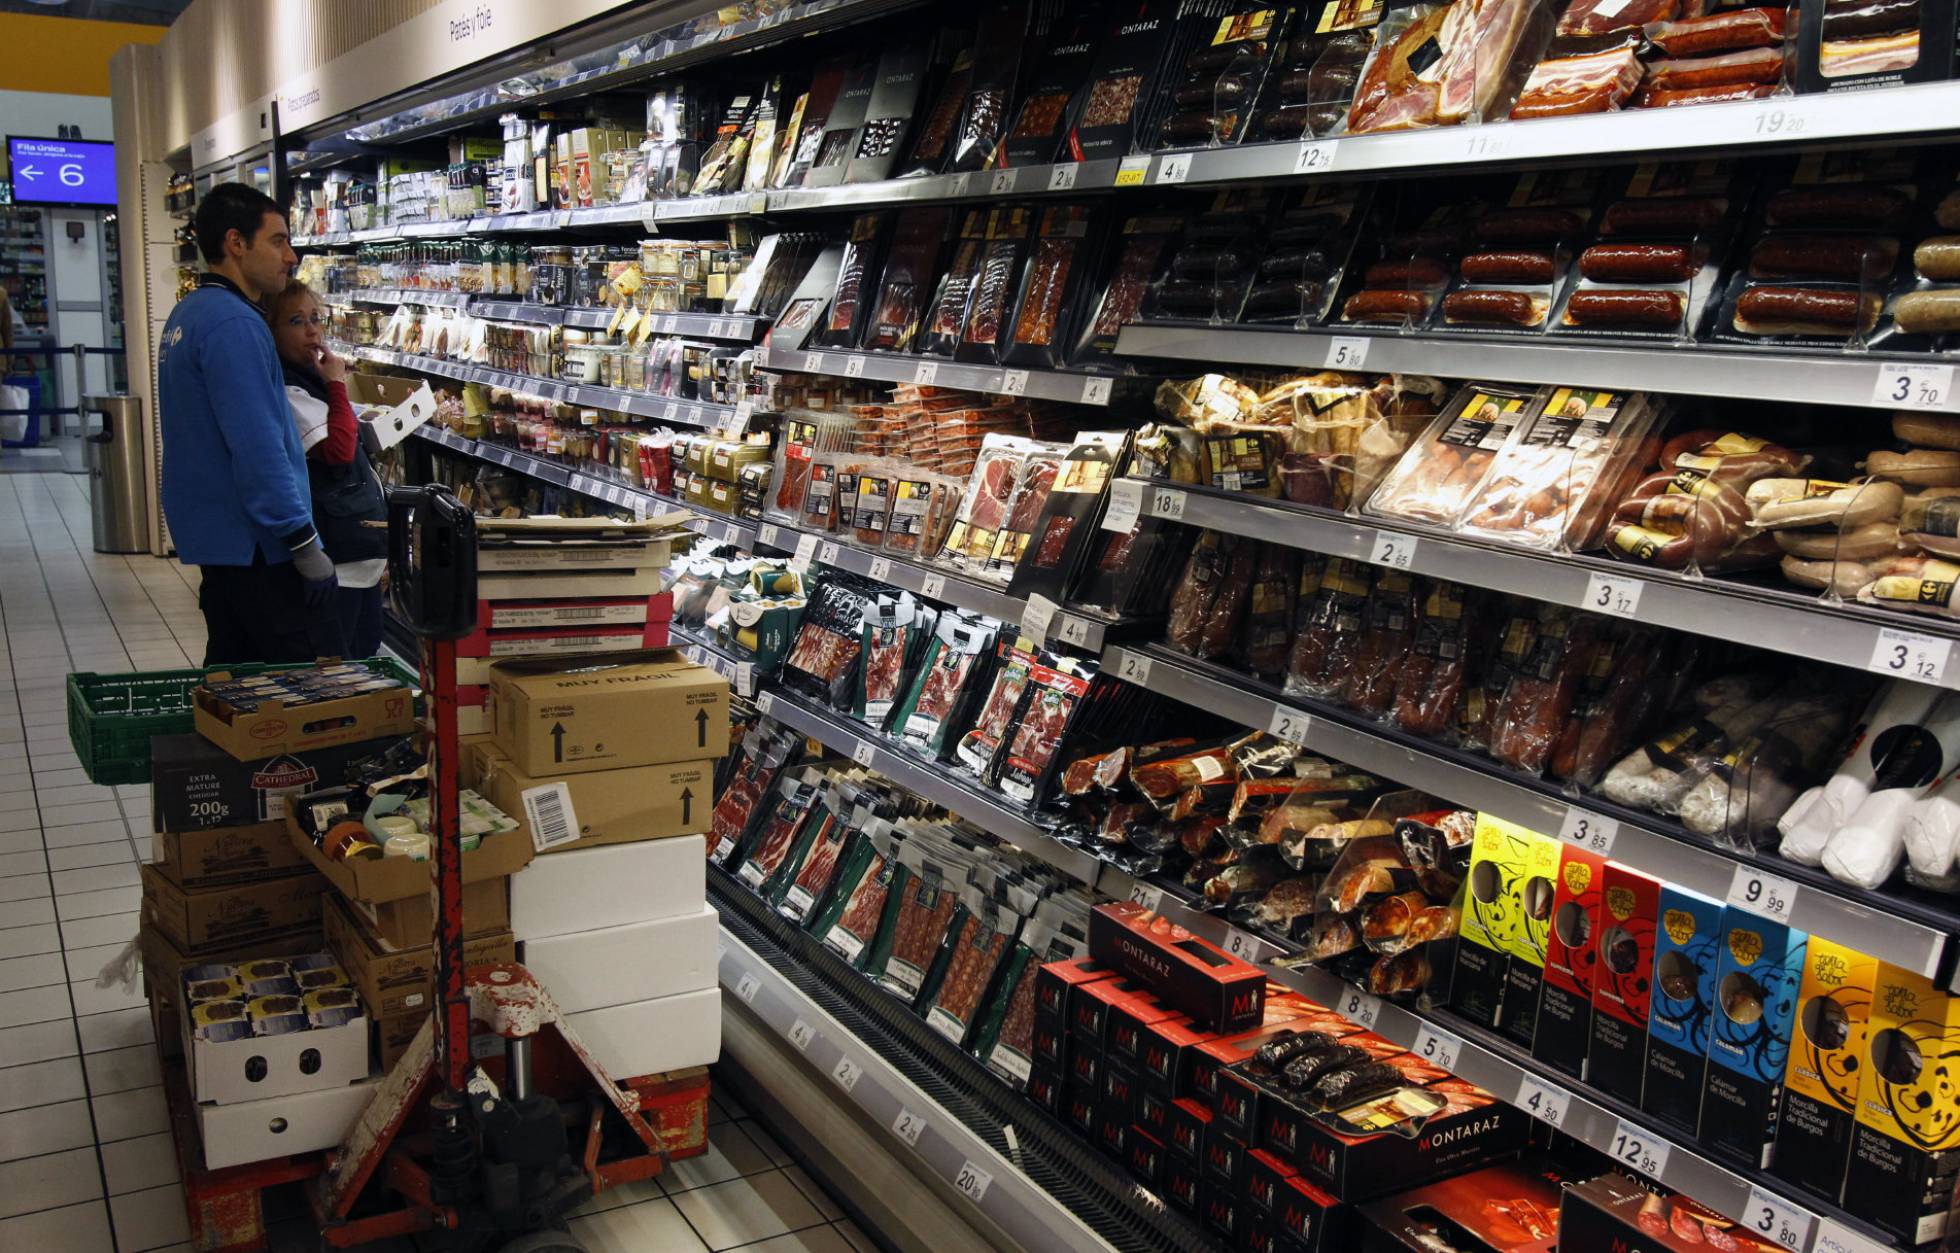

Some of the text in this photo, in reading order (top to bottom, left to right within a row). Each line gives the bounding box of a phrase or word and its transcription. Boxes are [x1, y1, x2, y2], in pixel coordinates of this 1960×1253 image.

[450, 14, 471, 42] Patés
[477, 5, 492, 32] foie
[1756, 109, 1786, 133] 19
[17, 143, 66, 153] Fila única
[1302, 149, 1320, 167] 12
[59, 164, 85, 187] 6
[1056, 172, 1065, 187] 2
[1165, 163, 1175, 179] 4
[997, 176, 1006, 190] 2
[1336, 346, 1348, 364] 5
[1008, 376, 1016, 391] 2
[1089, 384, 1098, 399] 4
[1892, 376, 1938, 403] 3 70
[1157, 496, 1171, 512] 18
[1380, 543, 1393, 562] 2
[1597, 585, 1631, 610] 3 17
[1066, 623, 1074, 638] 4
[1126, 660, 1135, 676] 2
[1889, 645, 1935, 676] 3 12
[556, 678, 601, 689] MUY
[1278, 718, 1291, 735] 2
[185, 782, 221, 792] MATURE
[189, 774, 217, 783] EXTRA
[255, 769, 314, 786] CATHEDRAL
[189, 801, 230, 817] 200g
[1574, 820, 1607, 848] 3 85
[1745, 879, 1784, 912] 9 99
[1232, 936, 1242, 953] 8
[1231, 993, 1250, 1016] M
[1348, 995, 1360, 1013] 8
[1423, 1037, 1438, 1056] 5
[1528, 1091, 1558, 1121] 4 50
[1789, 1093, 1819, 1116] Morcilla
[900, 1116, 911, 1132] 2
[1787, 1103, 1829, 1128] Tradicional
[1418, 1114, 1501, 1152] MONTARAZ
[1796, 1116, 1824, 1137] Burgos
[1860, 1128, 1890, 1151] Morcilla
[1617, 1135, 1657, 1173] 12 95
[1858, 1138, 1902, 1164] Tradicional
[1868, 1151, 1897, 1175] Burgos
[957, 1170, 976, 1190] 20
[1758, 1207, 1797, 1246] 3 80
